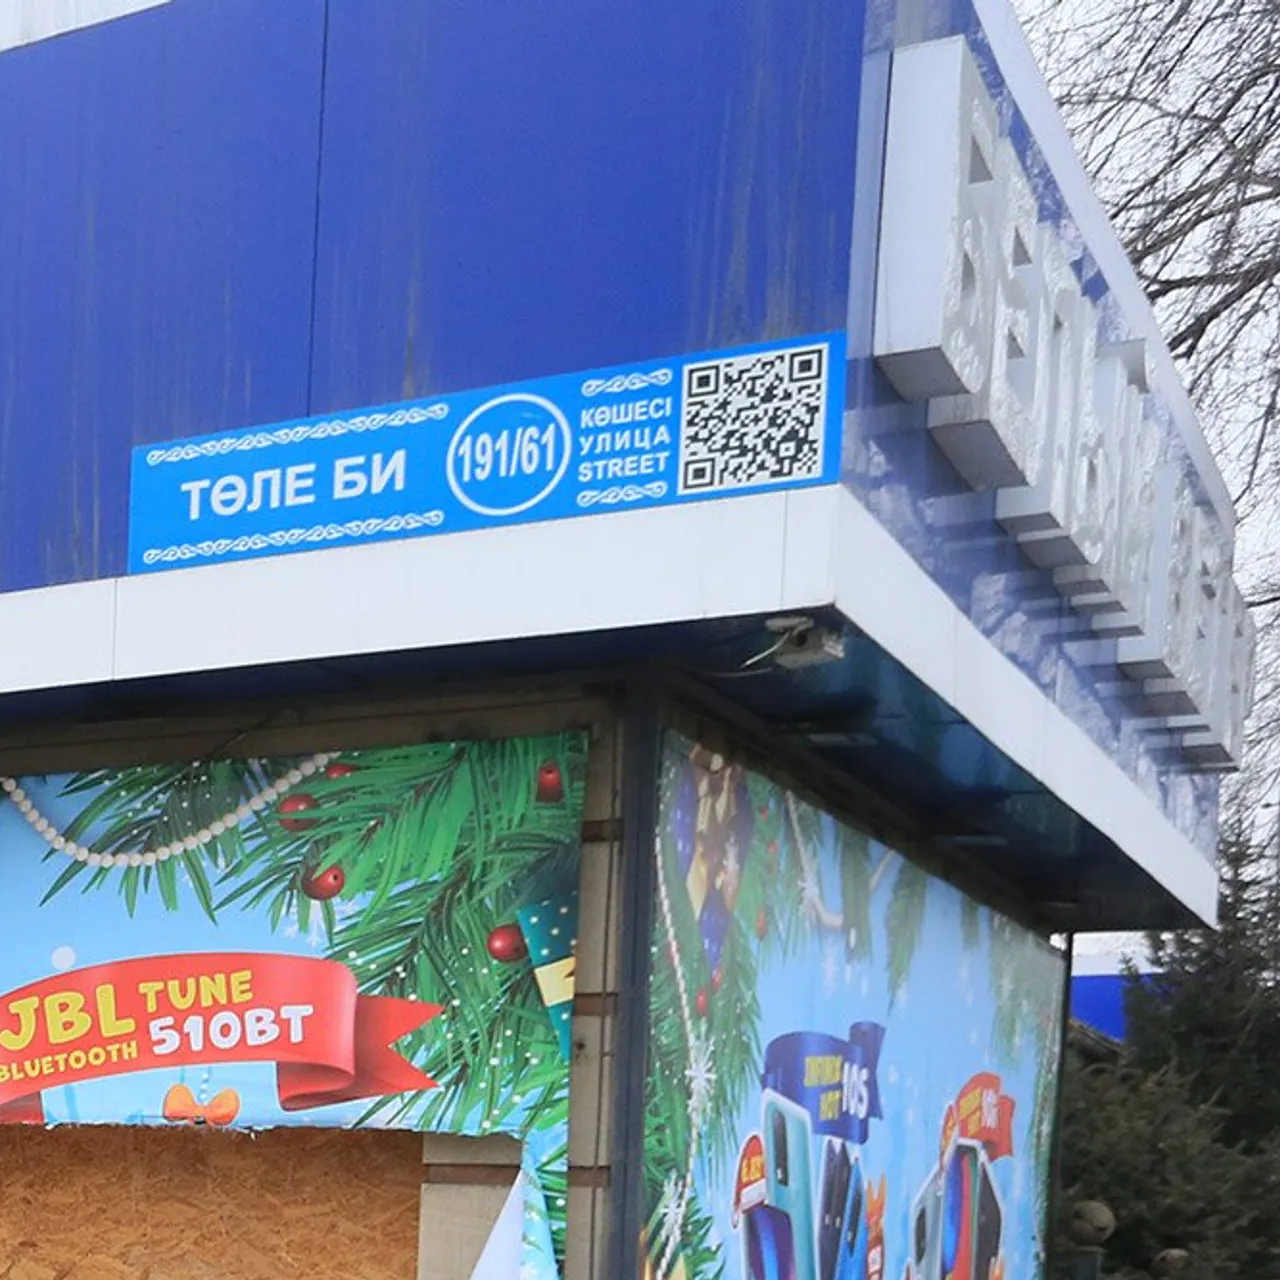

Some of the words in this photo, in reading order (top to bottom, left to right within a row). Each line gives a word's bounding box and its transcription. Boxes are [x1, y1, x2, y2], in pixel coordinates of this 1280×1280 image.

[580, 397, 672, 429] КӨШЕСІ
[458, 422, 556, 482] 191/61
[578, 424, 672, 456] УЛИЦА
[181, 463, 316, 520] ТӨЛЕ
[333, 449, 407, 500] БИ
[577, 451, 671, 483] STREET
[138, 970, 255, 1013] TUNE
[149, 1004, 314, 1056] 510BT
